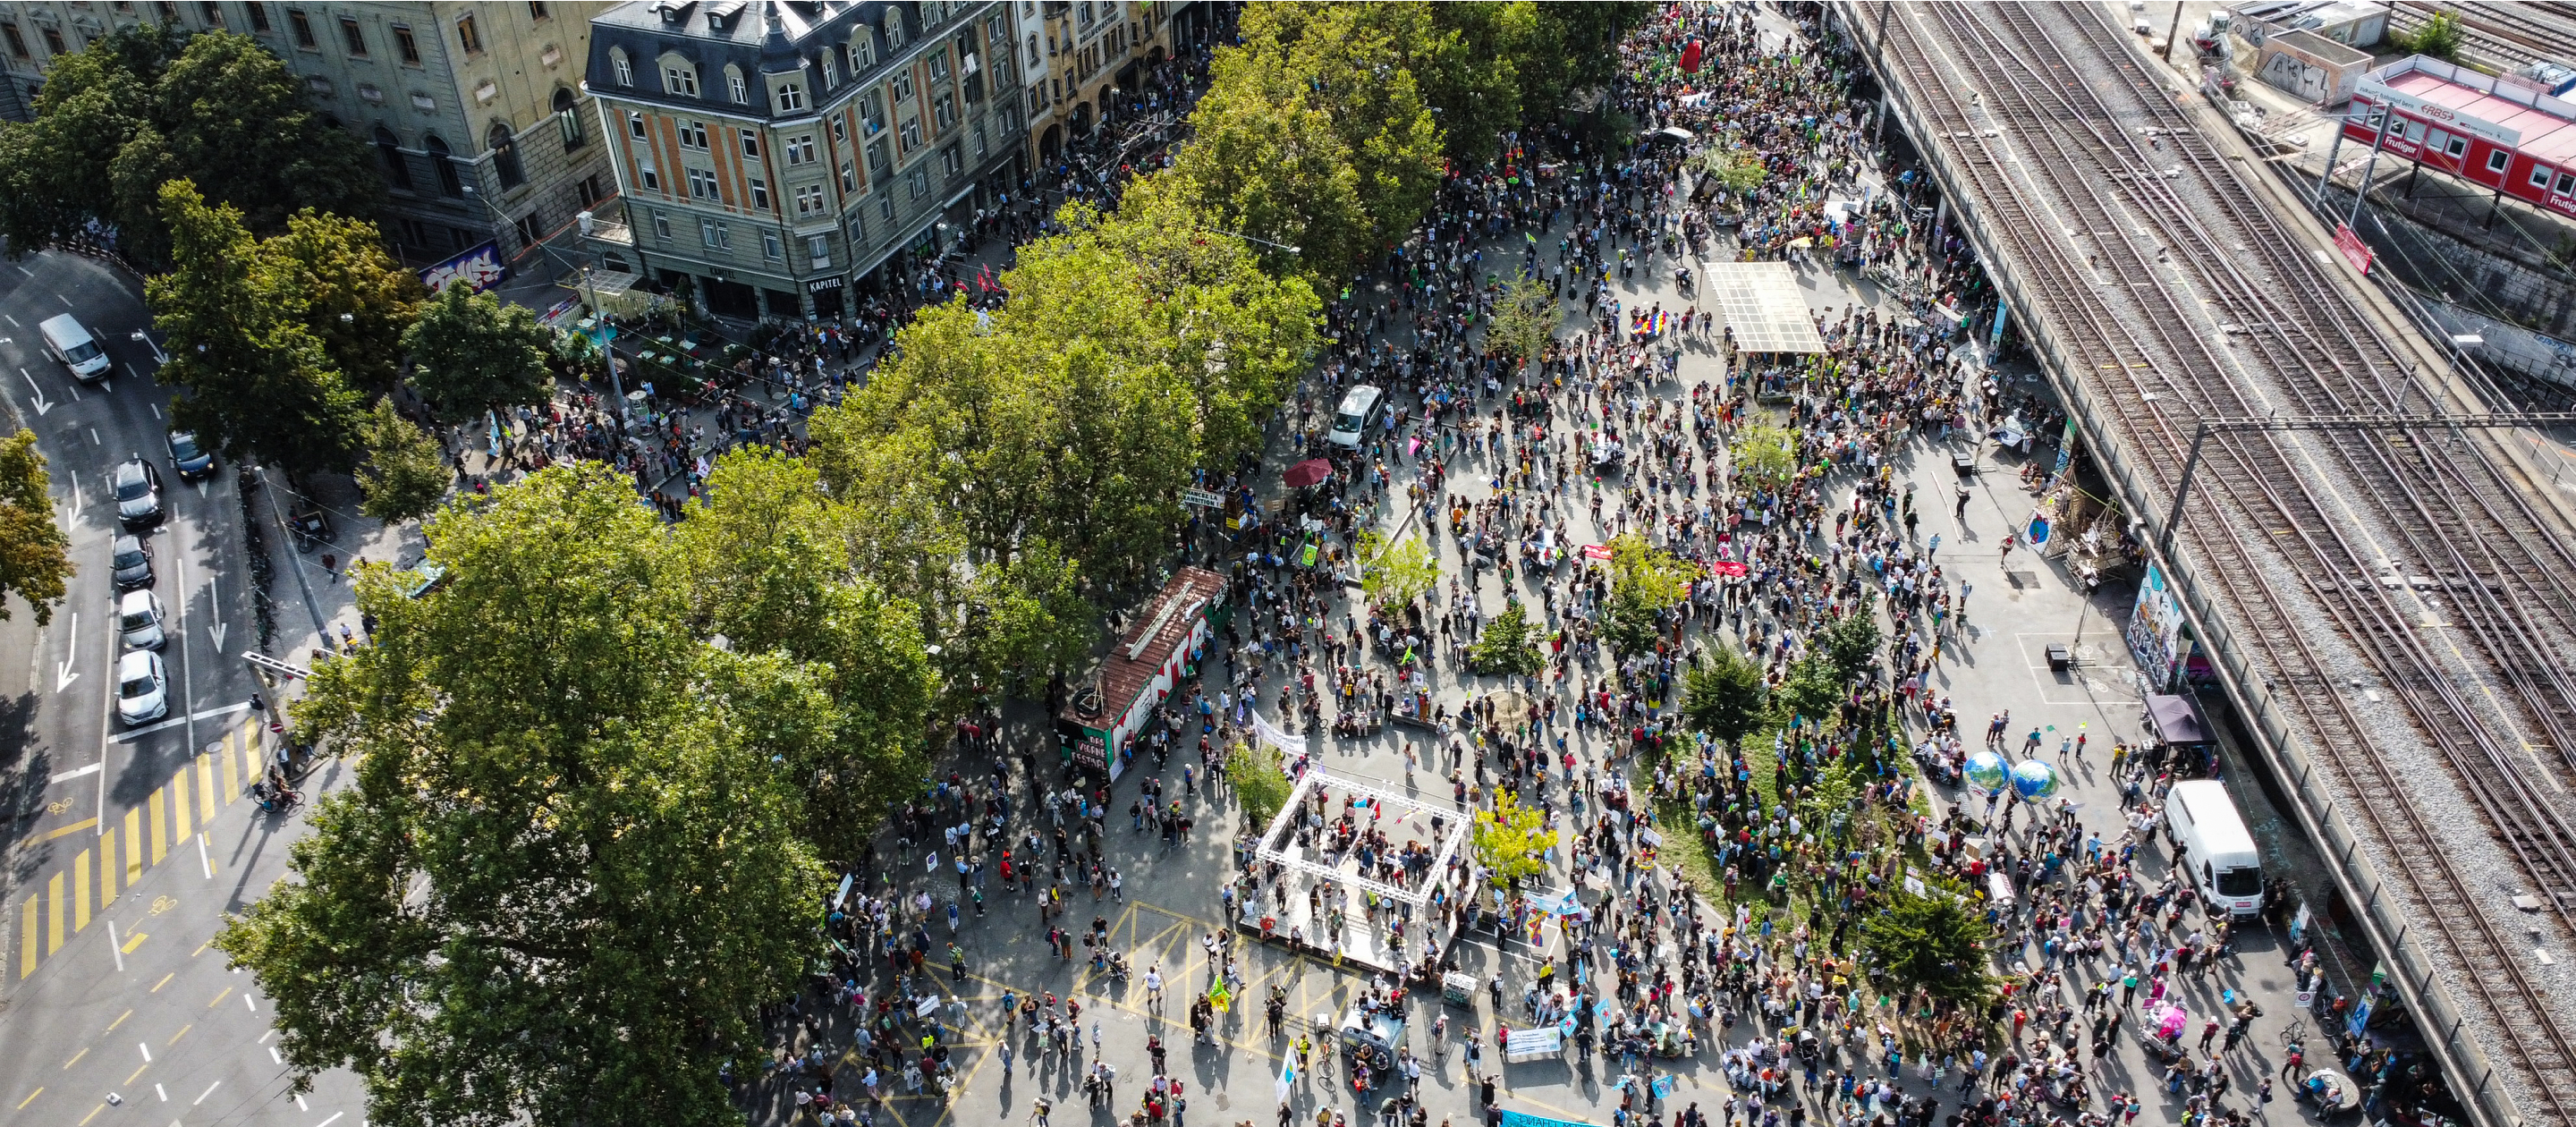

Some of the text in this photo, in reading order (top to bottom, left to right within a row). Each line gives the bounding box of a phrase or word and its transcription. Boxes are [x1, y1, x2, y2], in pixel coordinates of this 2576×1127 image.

[2427, 106, 2447, 120] RBS
[2385, 136, 2417, 154] Frutiger
[809, 277, 843, 293] KAPITEL
[1183, 488, 1218, 501] NANCEZ LA
[1078, 741, 1106, 758] VEGANE
[1090, 736, 1105, 747] DAS
[1072, 752, 1106, 770] FESTIVAL
